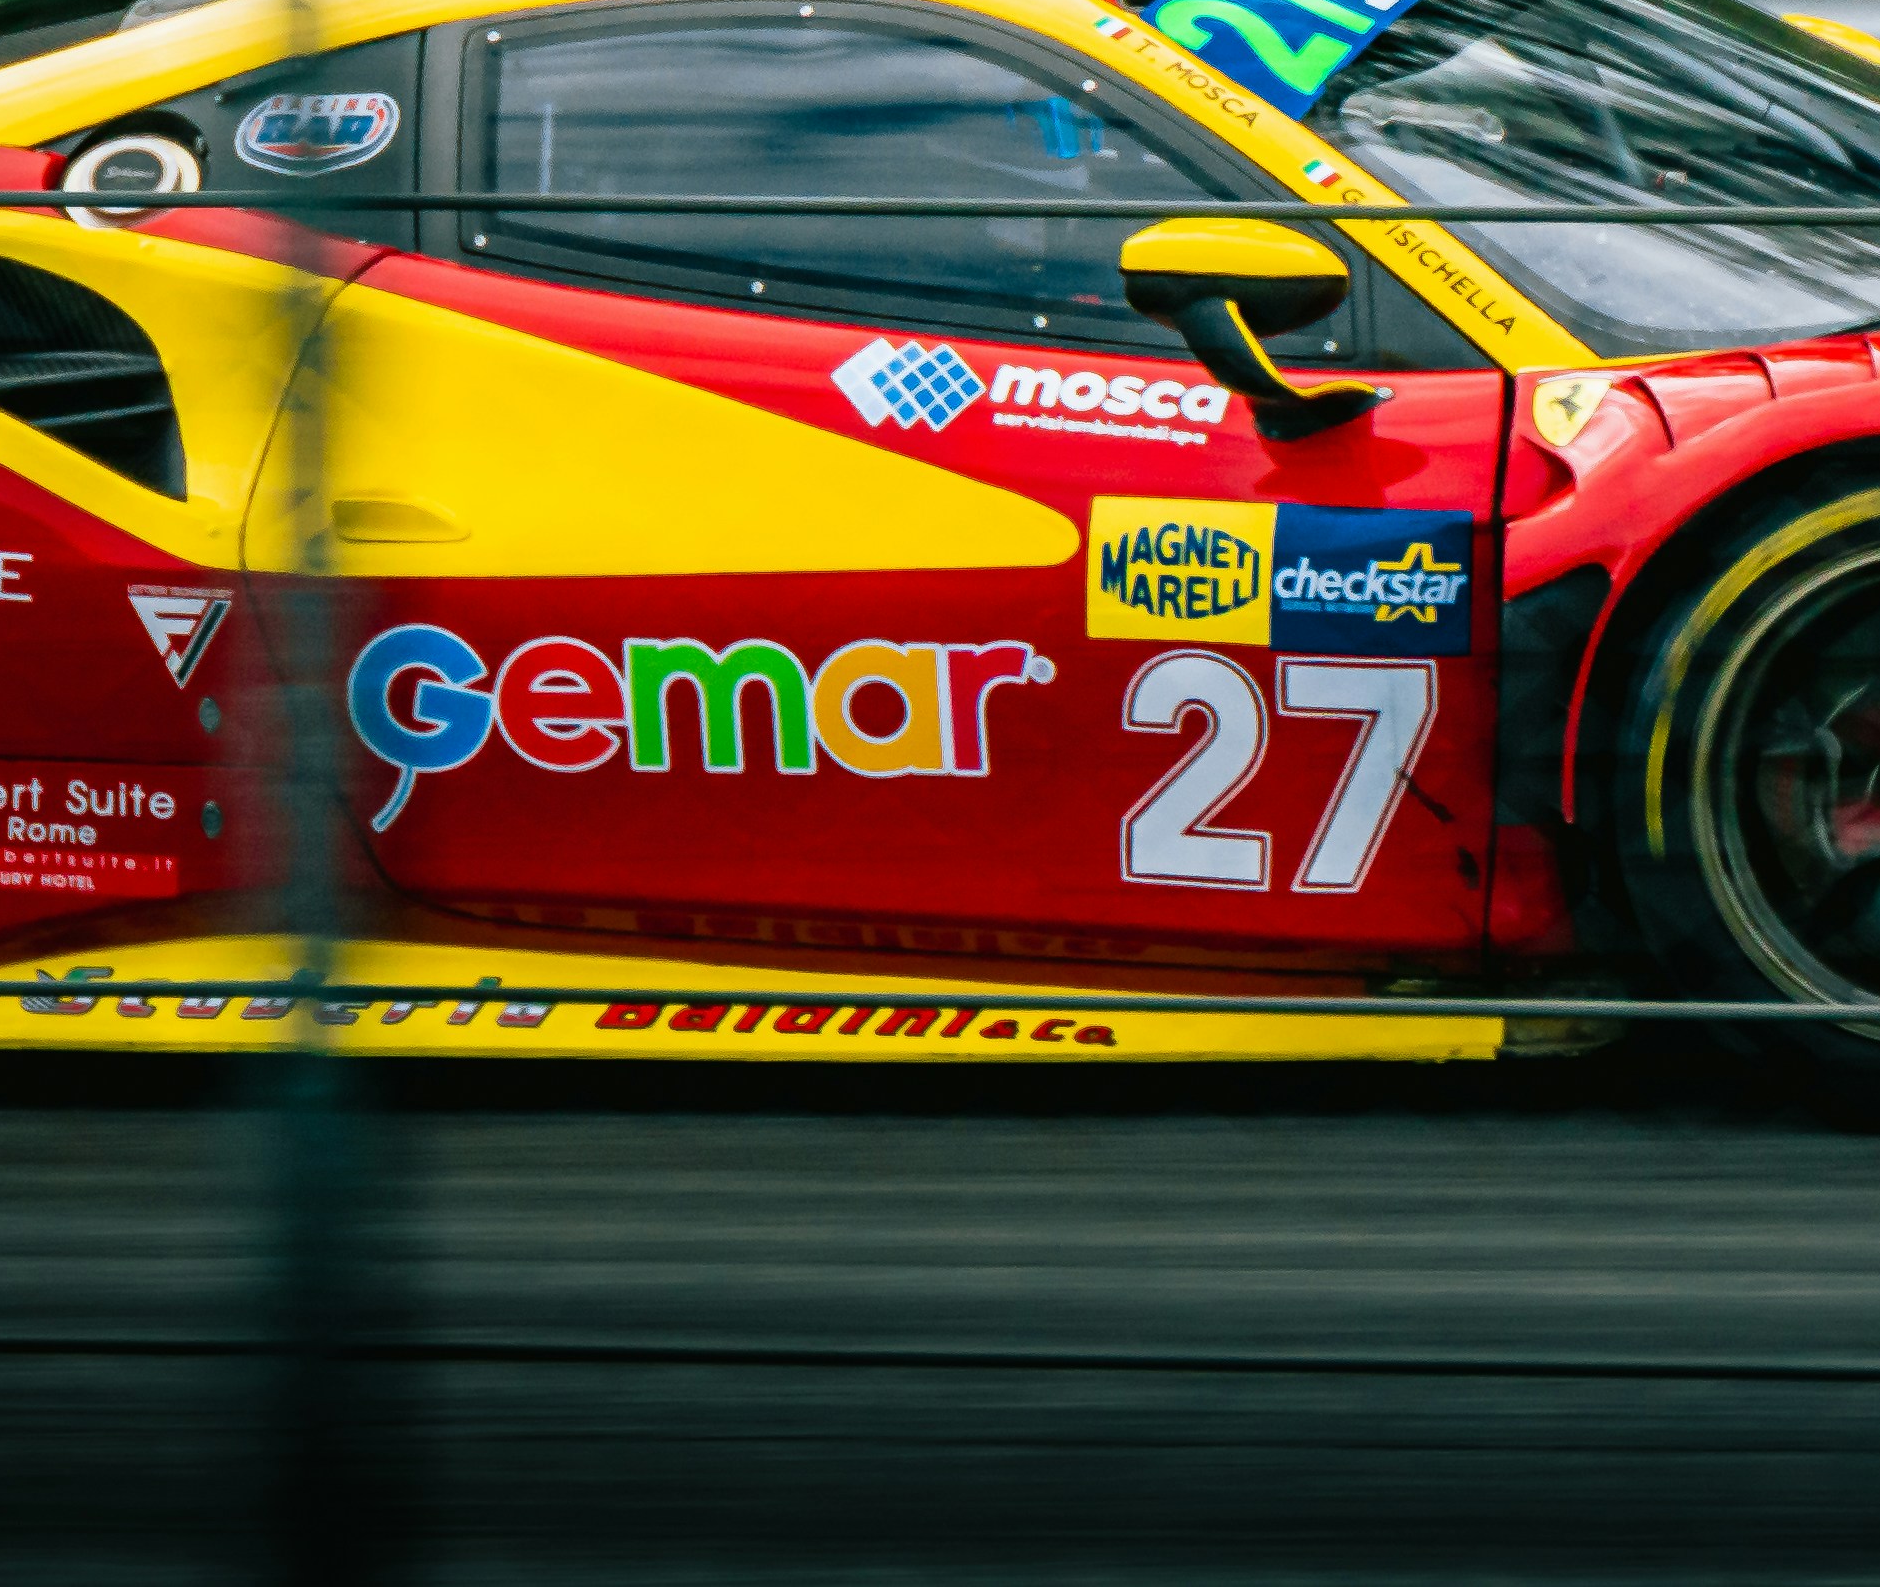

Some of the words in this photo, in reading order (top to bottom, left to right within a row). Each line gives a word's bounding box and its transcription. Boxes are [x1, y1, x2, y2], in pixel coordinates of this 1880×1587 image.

[1166, 61, 1259, 128] MOSCA
[1369, 219, 1517, 336] ISICHELLA
[989, 363, 1232, 424] mosca
[1274, 556, 1467, 606] checkstar
[347, 621, 1057, 833] Gemar
[66, 779, 177, 820] Suite
[1119, 649, 1438, 894] 27
[8, 815, 98, 845] Rome
